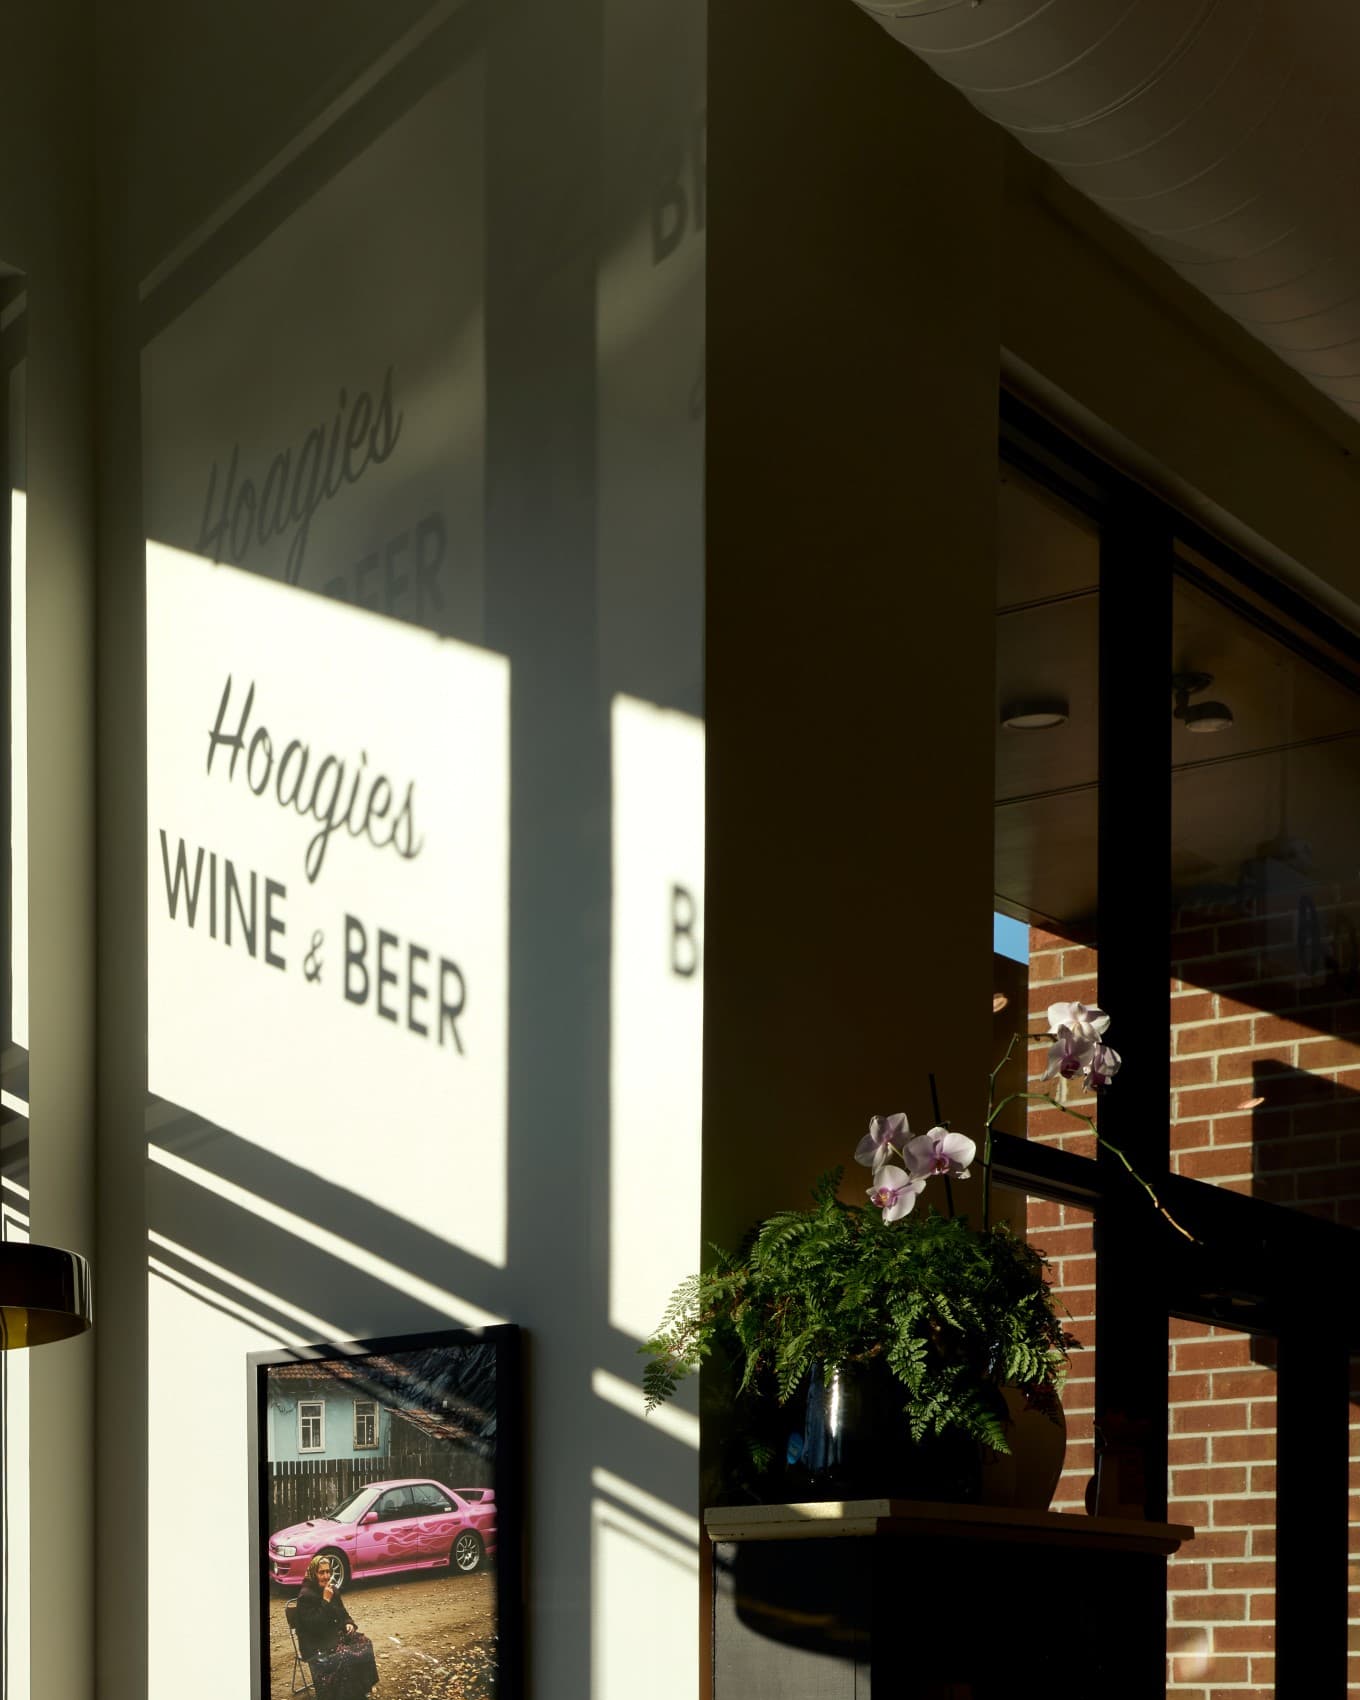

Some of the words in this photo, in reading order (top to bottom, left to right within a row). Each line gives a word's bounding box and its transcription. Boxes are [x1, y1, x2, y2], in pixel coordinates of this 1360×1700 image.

[207, 673, 424, 884] Hoagies
[159, 828, 287, 972] WINE
[303, 929, 324, 983] &
[344, 912, 467, 1057] BEER
